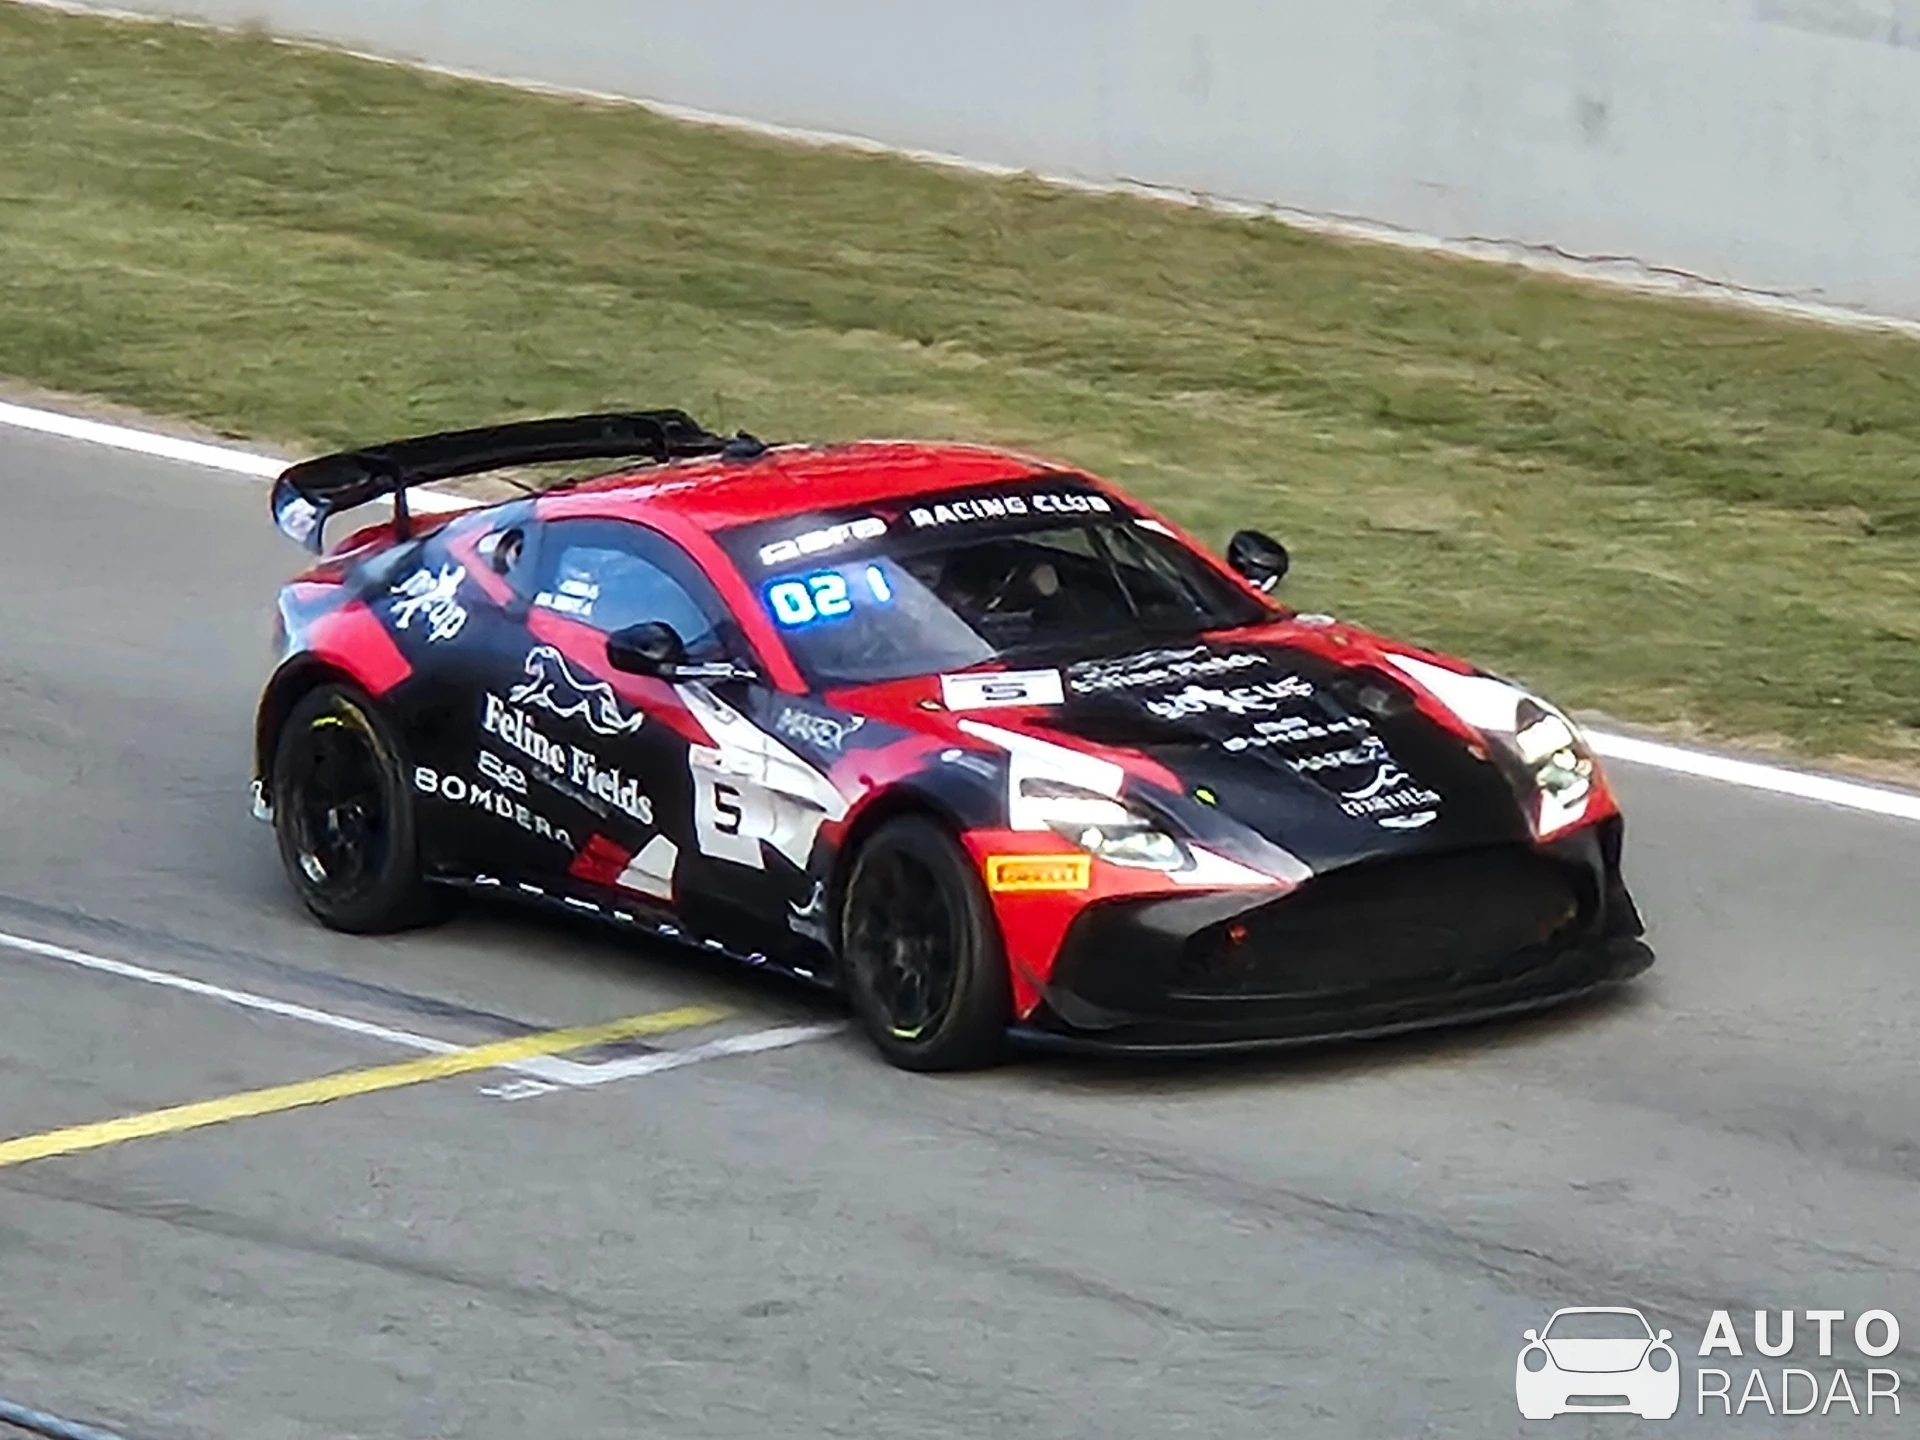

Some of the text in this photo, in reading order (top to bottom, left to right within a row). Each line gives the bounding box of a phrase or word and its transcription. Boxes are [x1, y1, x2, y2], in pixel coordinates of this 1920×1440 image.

[909, 494, 1111, 527] RACING CLUB
[483, 692, 566, 775] Feline
[569, 744, 654, 825] Fields
[714, 782, 742, 836] 5
